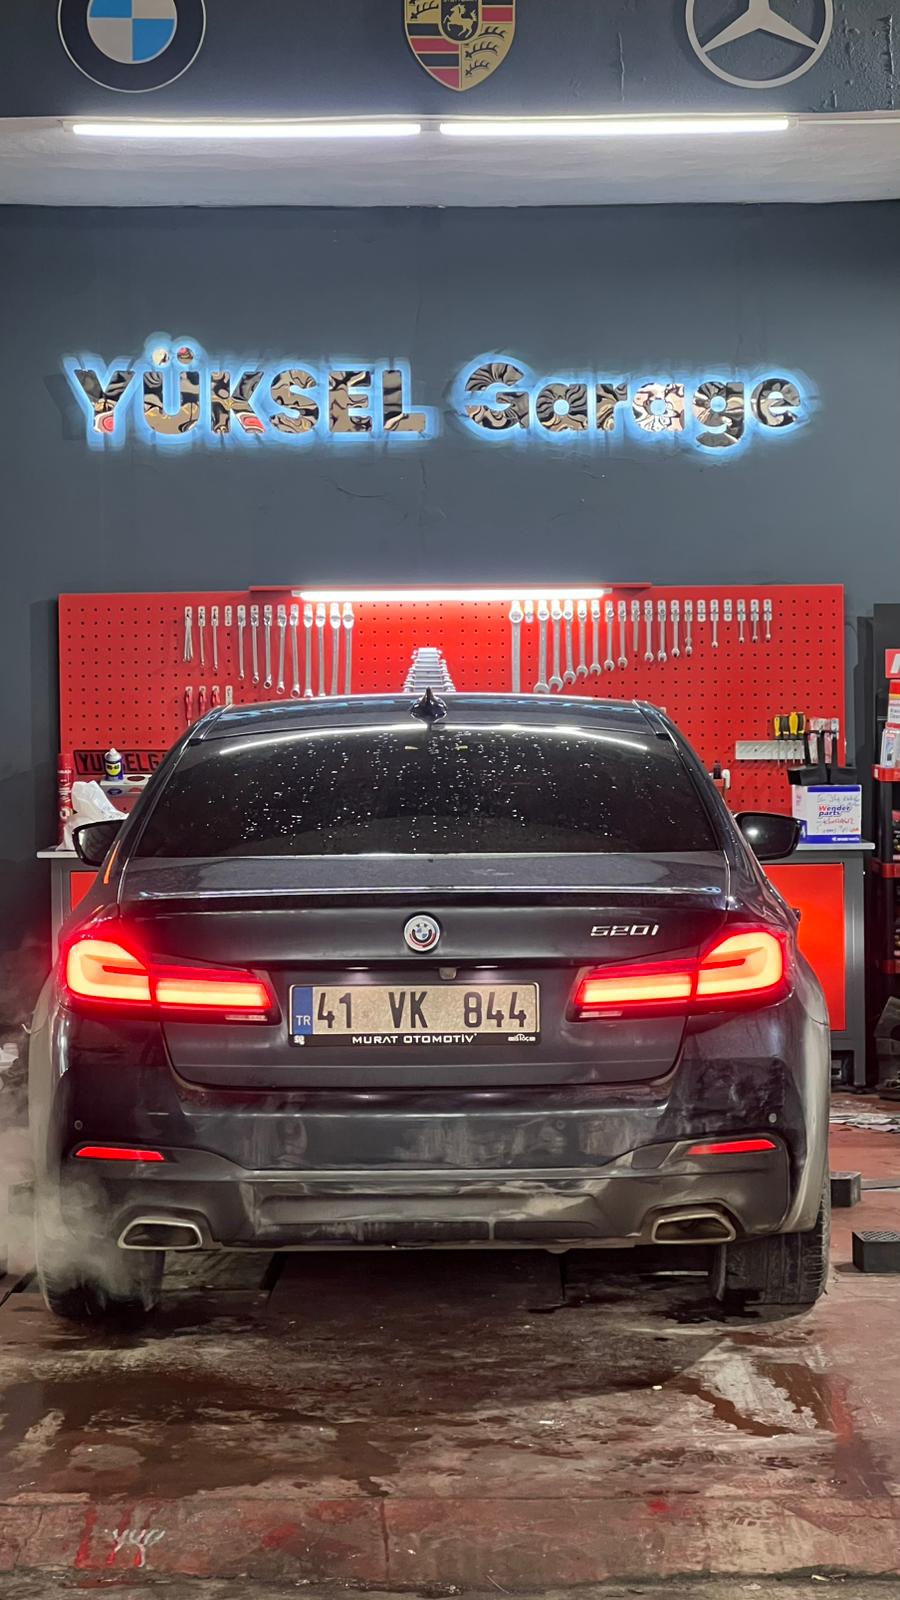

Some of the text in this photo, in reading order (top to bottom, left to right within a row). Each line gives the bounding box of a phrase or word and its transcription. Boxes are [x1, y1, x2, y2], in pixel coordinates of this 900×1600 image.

[72, 344, 803, 449] YÜKSEL Garage
[296, 1015, 312, 1026] TR
[317, 991, 527, 1029] 41 VK 844
[352, 1036, 398, 1044] MURAT
